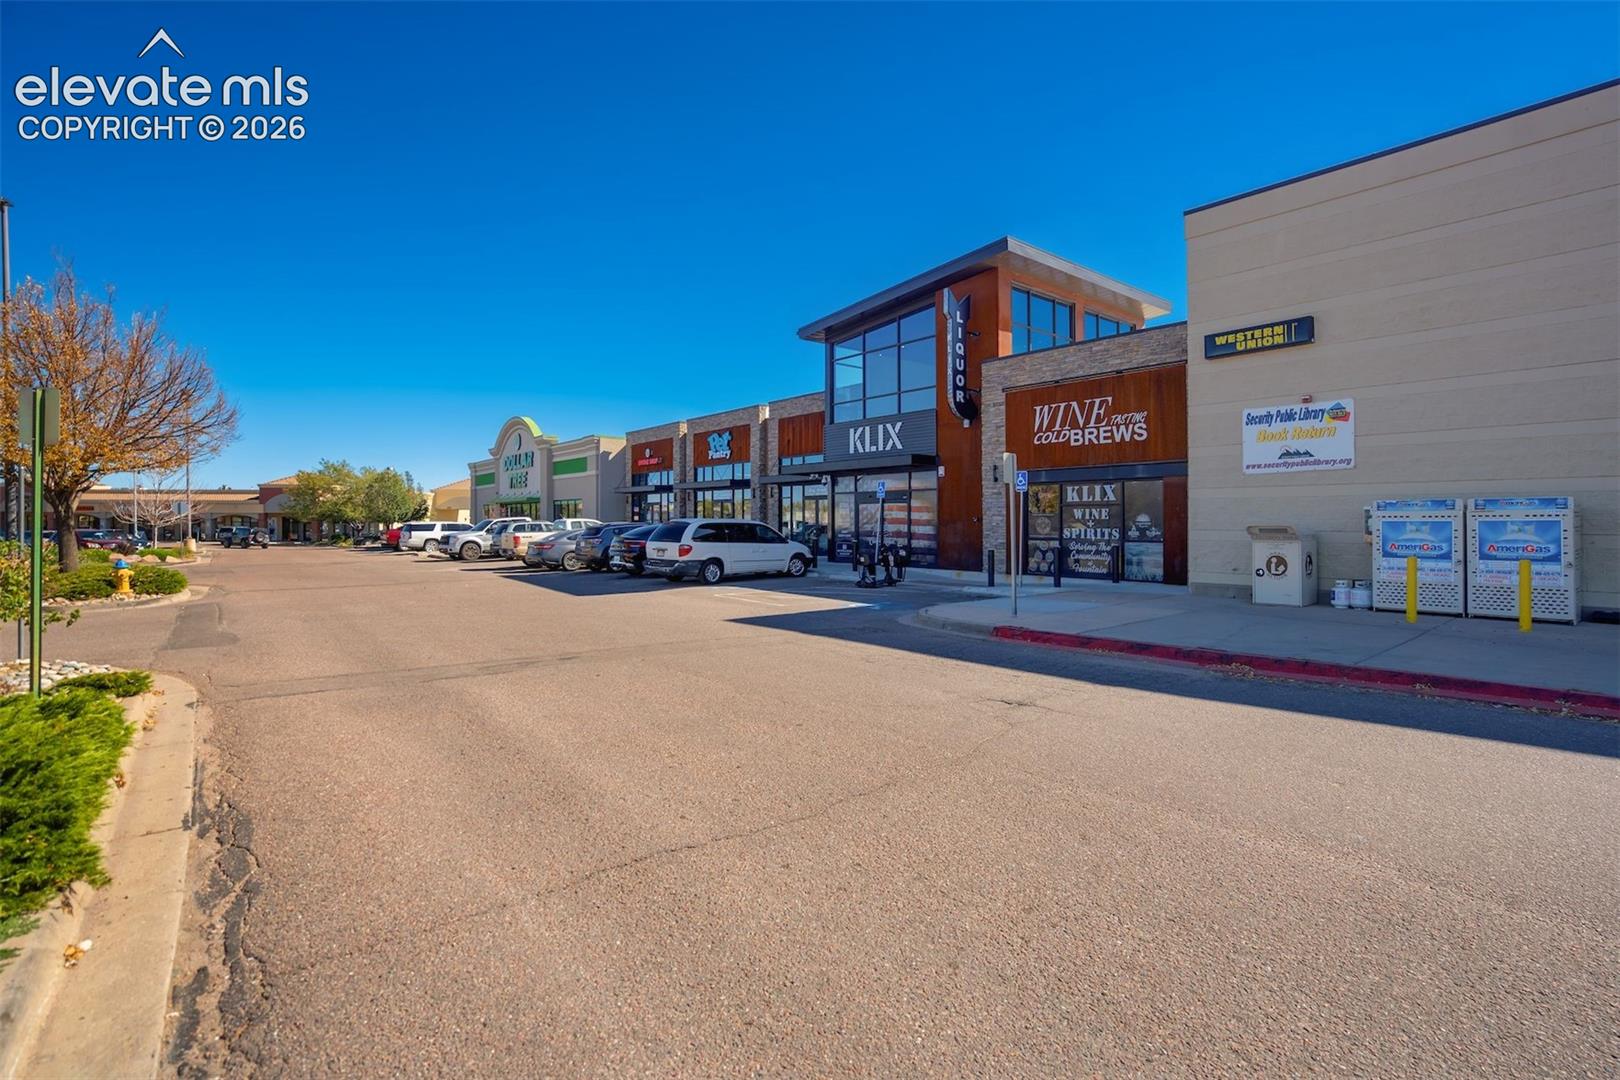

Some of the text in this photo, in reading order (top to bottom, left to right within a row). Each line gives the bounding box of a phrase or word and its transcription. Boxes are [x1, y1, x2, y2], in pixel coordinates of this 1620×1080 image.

[1215, 325, 1284, 345] WESTERN
[1236, 335, 1285, 350] UNION
[956, 310, 965, 403] LIQUOR
[1033, 396, 1113, 433] WINE
[1110, 410, 1148, 425] TASTING
[1245, 411, 1274, 427] Security
[1274, 408, 1298, 424] Public
[1298, 407, 1326, 422] Library
[849, 421, 903, 454] KLIX
[1033, 422, 1148, 447] COLD BREWS
[1257, 426, 1337, 443] Book Return
[503, 451, 534, 471] DOLLAR
[508, 471, 529, 489] TREE
[1066, 484, 1117, 502] KLIX
[1073, 508, 1109, 520] WINE
[1062, 528, 1120, 541] SPIRITS
[1389, 543, 1445, 552] AmeriGas
[1487, 544, 1552, 554] AmeriGas
